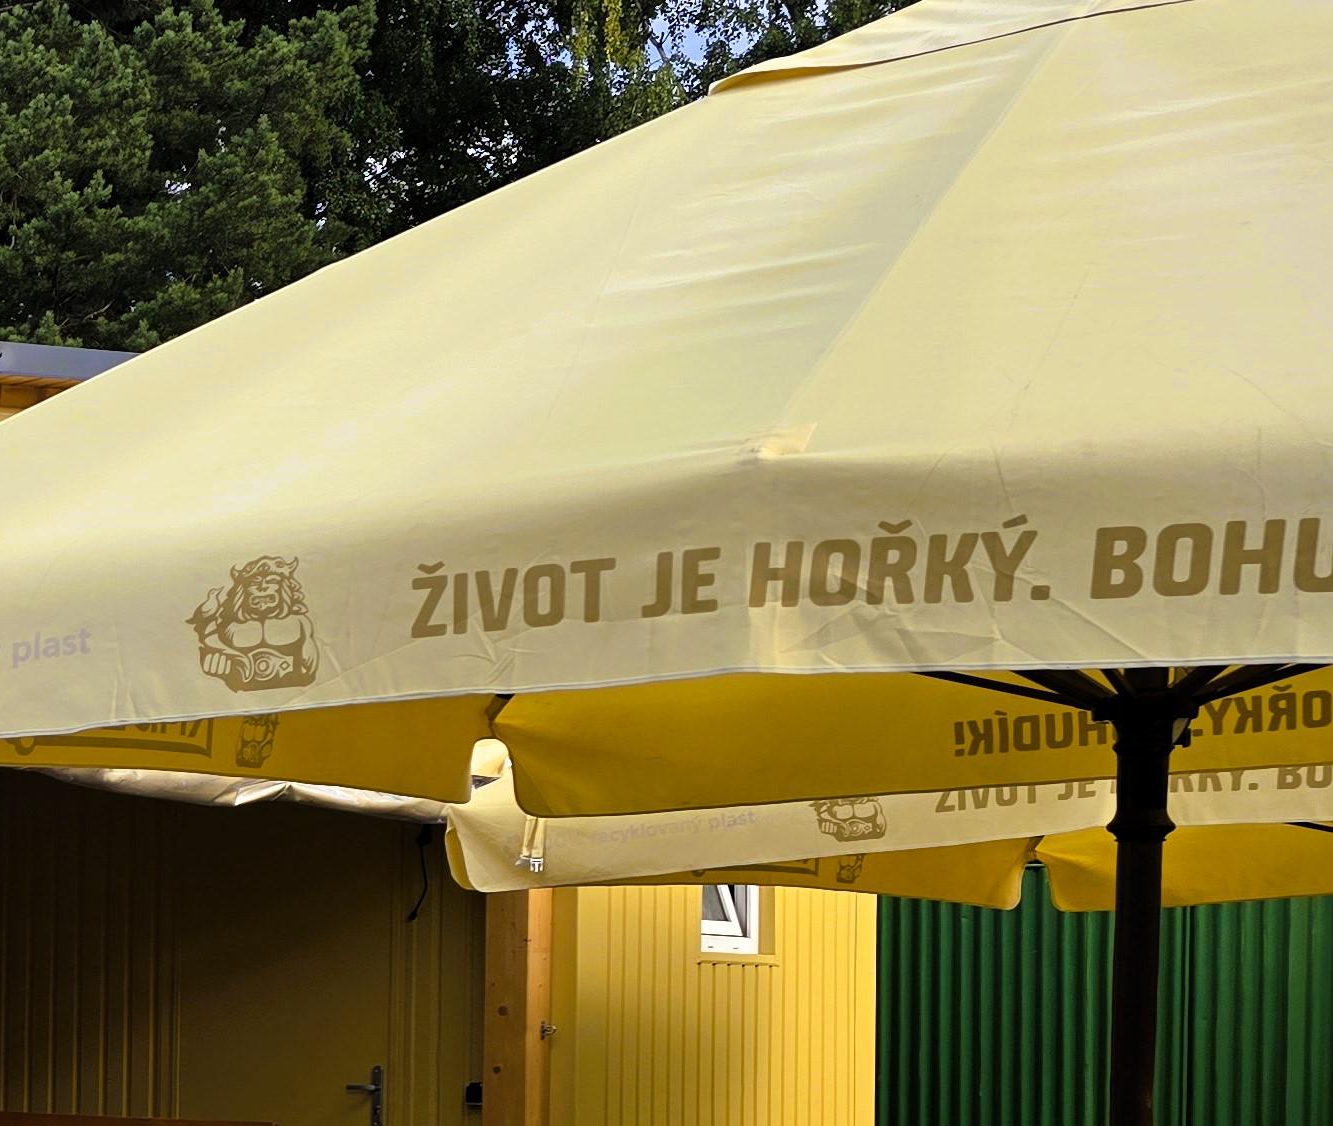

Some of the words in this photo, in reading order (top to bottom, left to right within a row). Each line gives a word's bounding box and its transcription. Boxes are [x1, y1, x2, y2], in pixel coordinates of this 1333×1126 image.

[411, 556, 617, 639] ŽIVOT
[641, 546, 722, 619] JE
[748, 514, 1051, 607] HOŘKÝ.
[11, 626, 93, 670] plast
